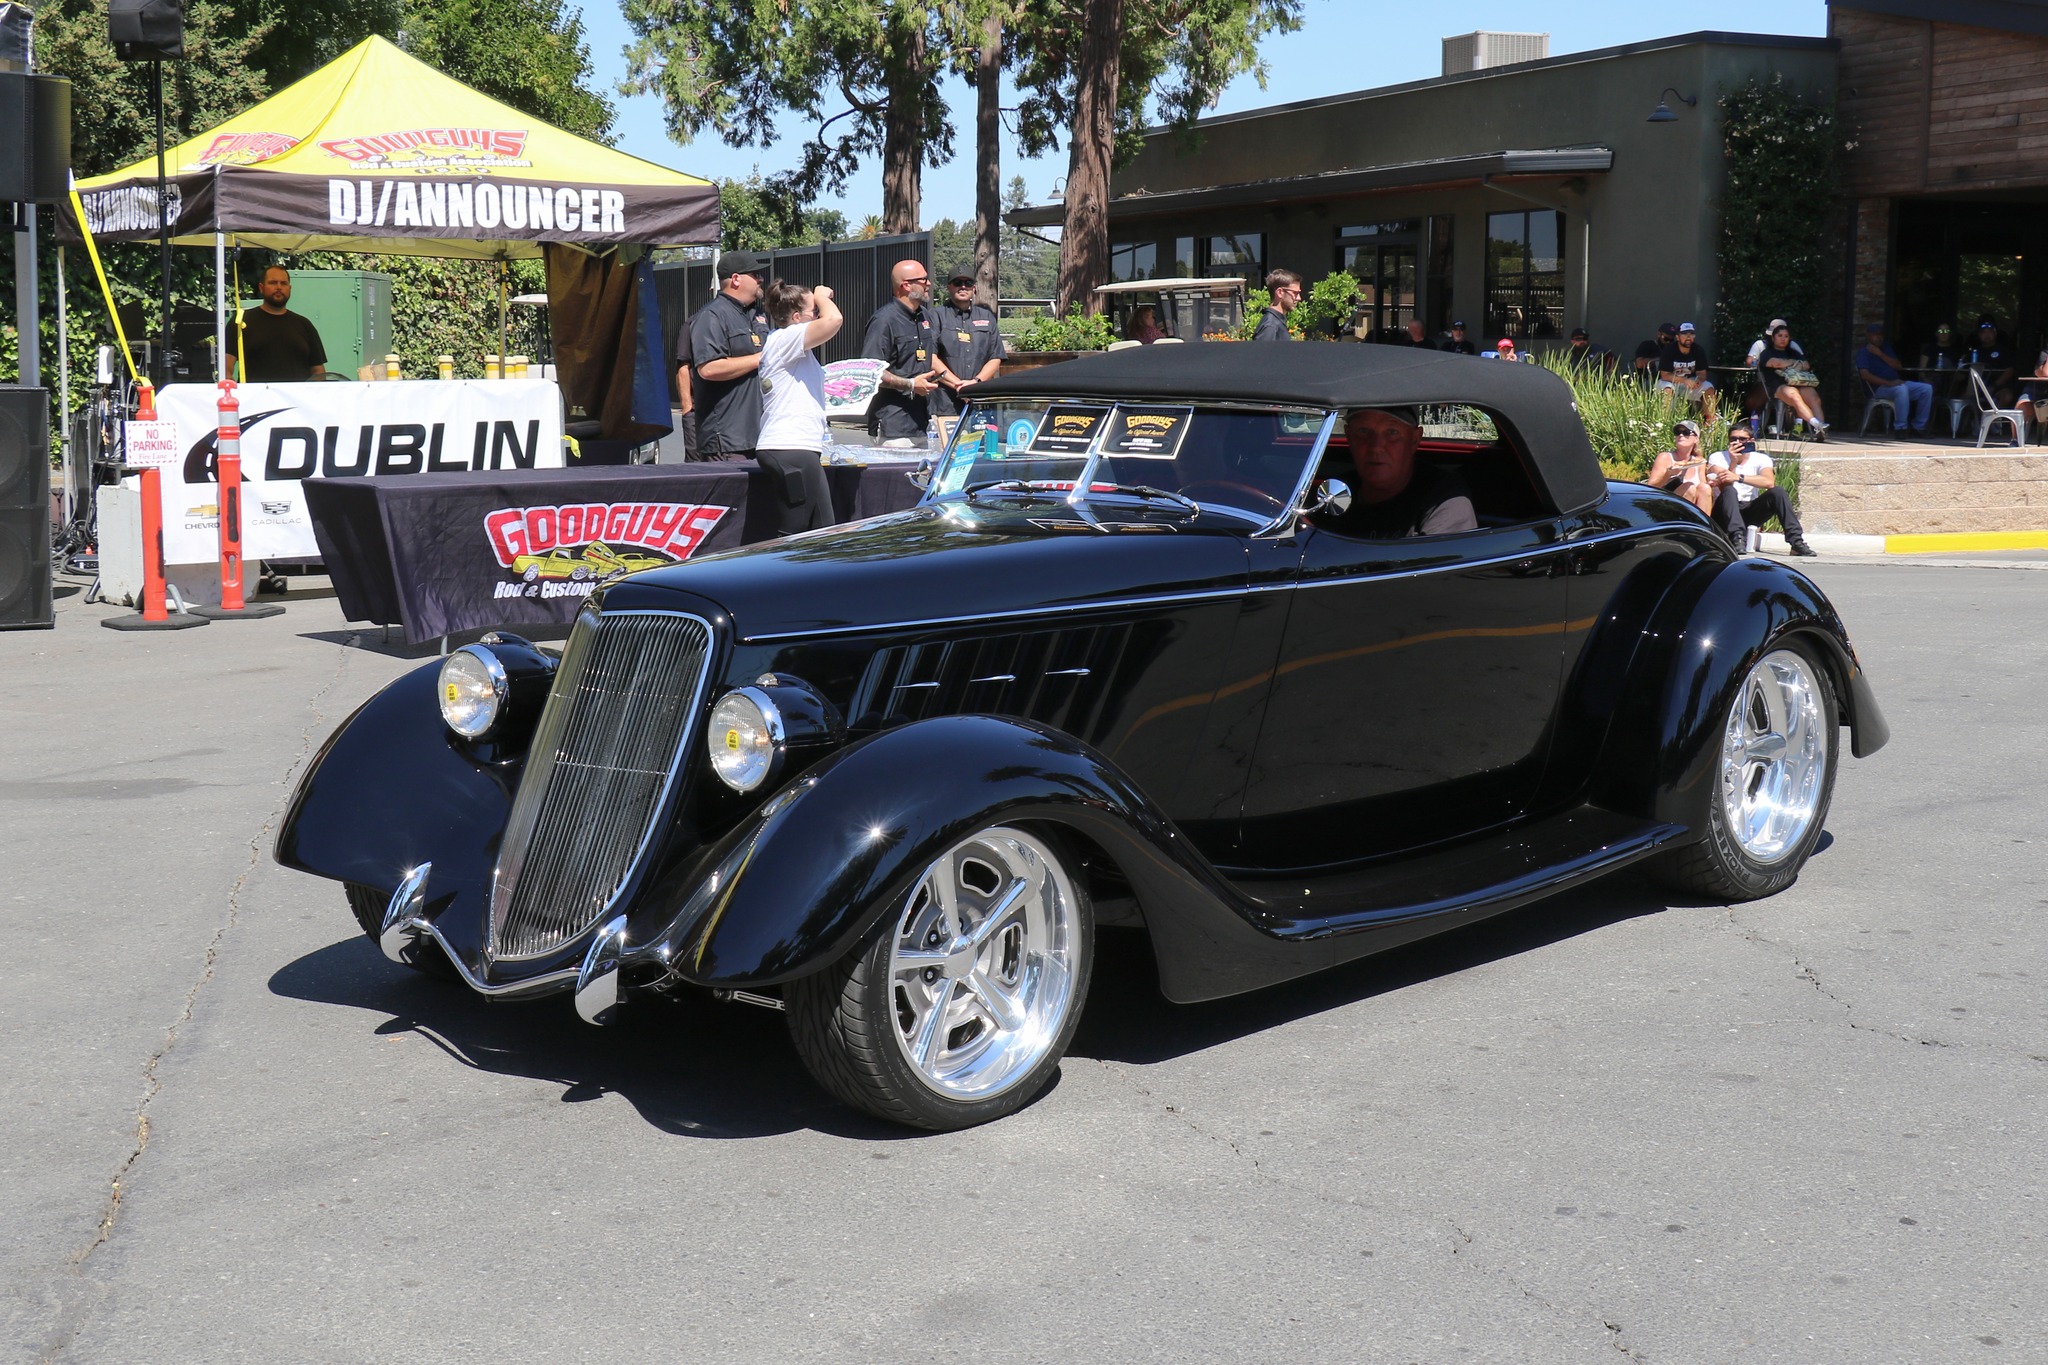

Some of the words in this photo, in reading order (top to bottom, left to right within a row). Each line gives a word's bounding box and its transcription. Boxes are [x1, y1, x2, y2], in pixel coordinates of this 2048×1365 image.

[317, 128, 529, 162] GOODGUYS
[392, 158, 446, 168] Custom
[449, 158, 532, 168] Association
[328, 179, 626, 233] DJ/ANNOUNCER
[1054, 415, 1096, 429] GOODGUYS
[1126, 415, 1178, 429] GOODGUYS
[145, 429, 160, 440] NO
[133, 440, 173, 452] PARKING
[264, 420, 540, 481] DUBLIN
[184, 522, 220, 530] CHEVRO
[251, 517, 302, 526] CADILLAC
[483, 502, 731, 569] GOODGUYS
[493, 581, 525, 599] Rod
[524, 584, 538, 598] &
[540, 580, 594, 599] Custom
